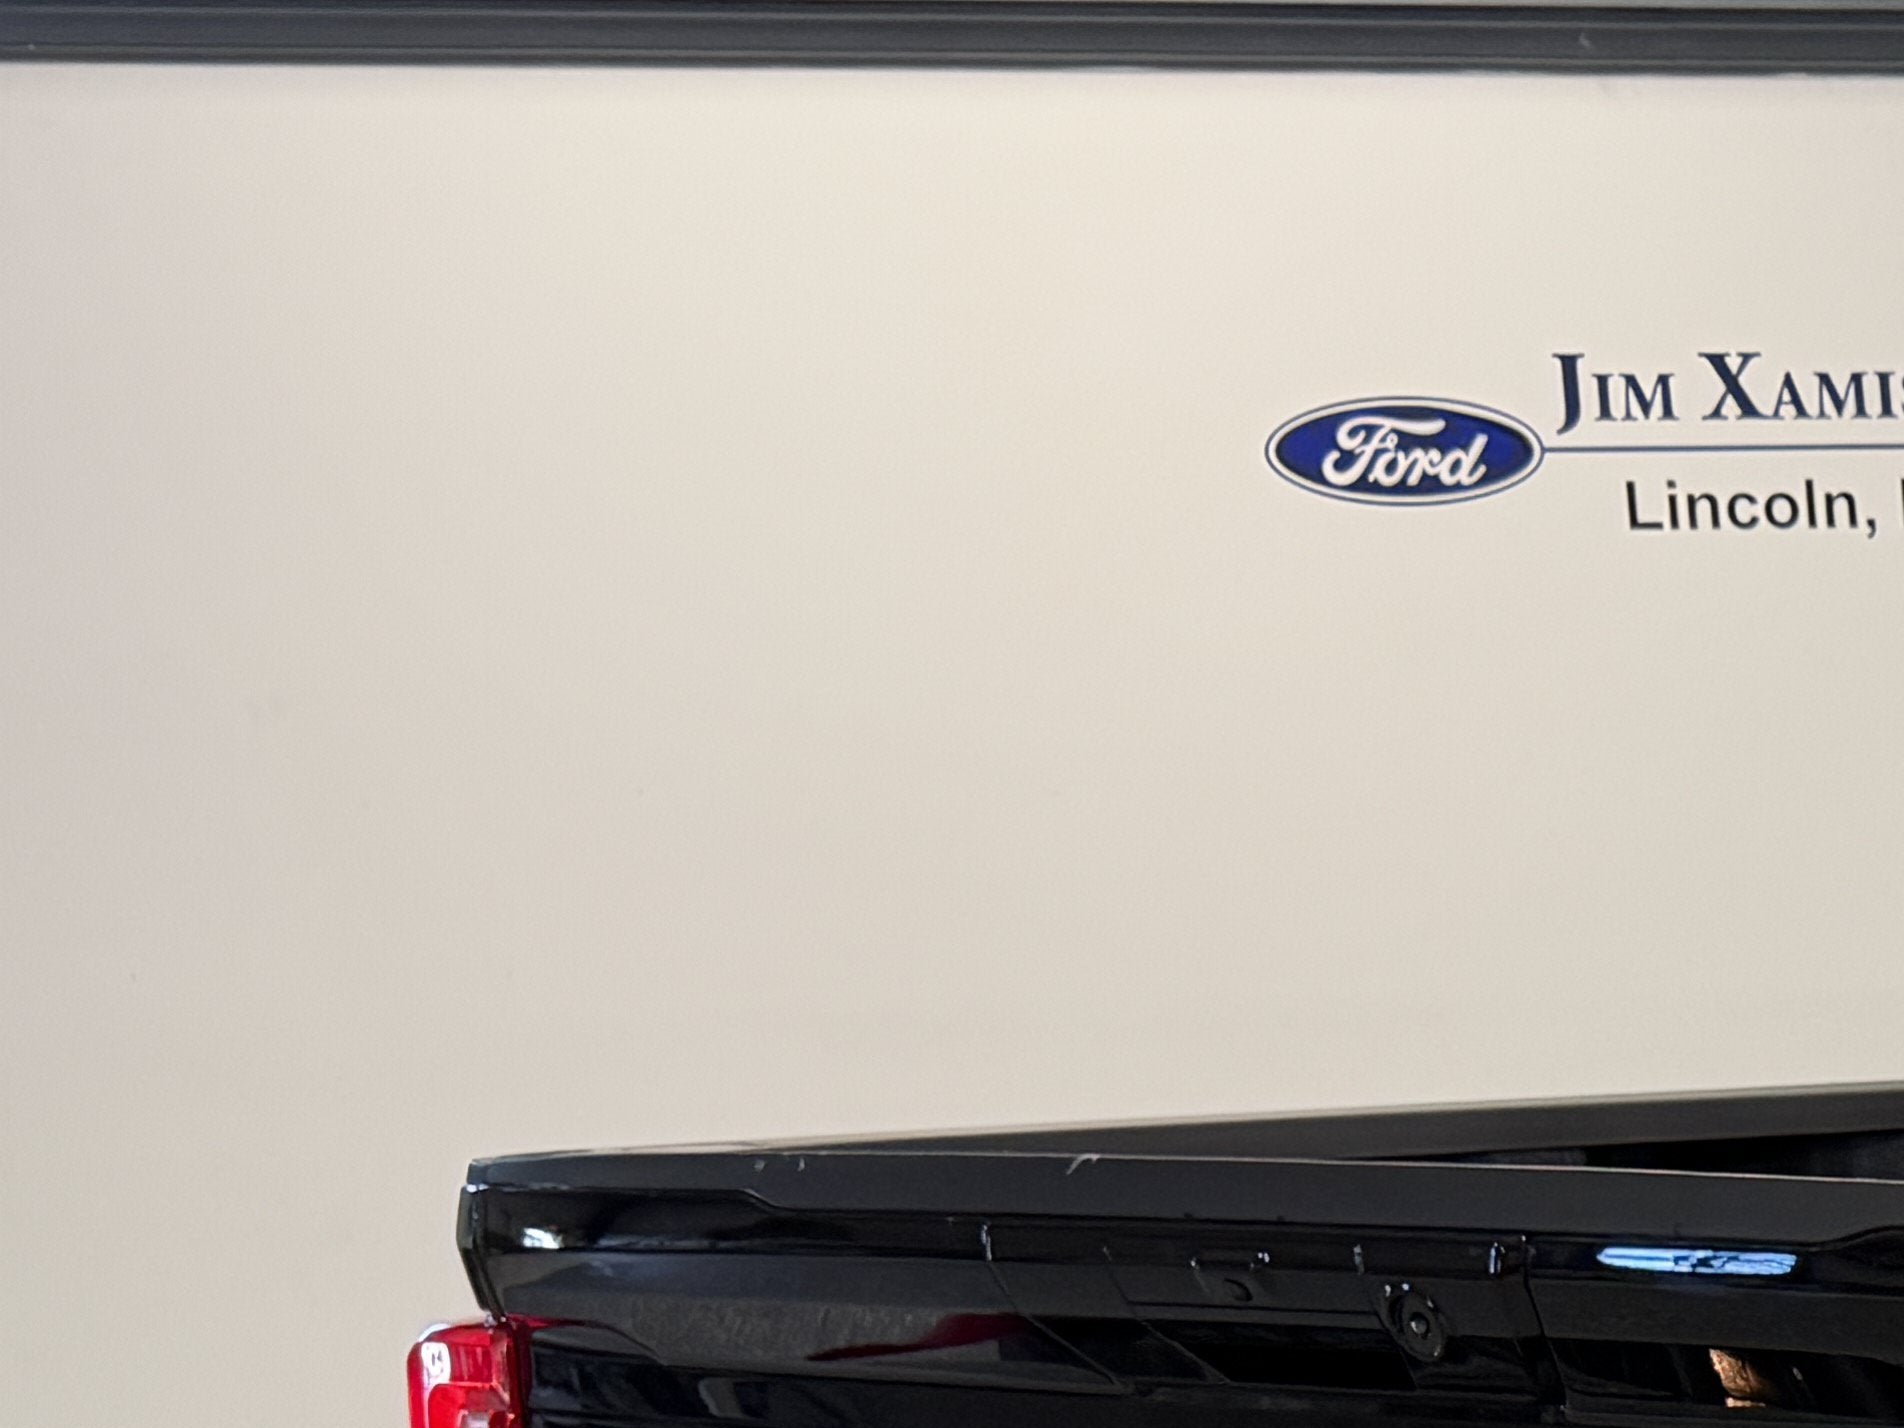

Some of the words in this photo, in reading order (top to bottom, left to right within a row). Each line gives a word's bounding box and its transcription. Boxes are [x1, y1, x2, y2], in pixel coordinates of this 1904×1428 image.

[1551, 352, 1680, 435] JIM
[1321, 415, 1490, 488] Ford
[1625, 478, 1878, 539] Lincoln,
